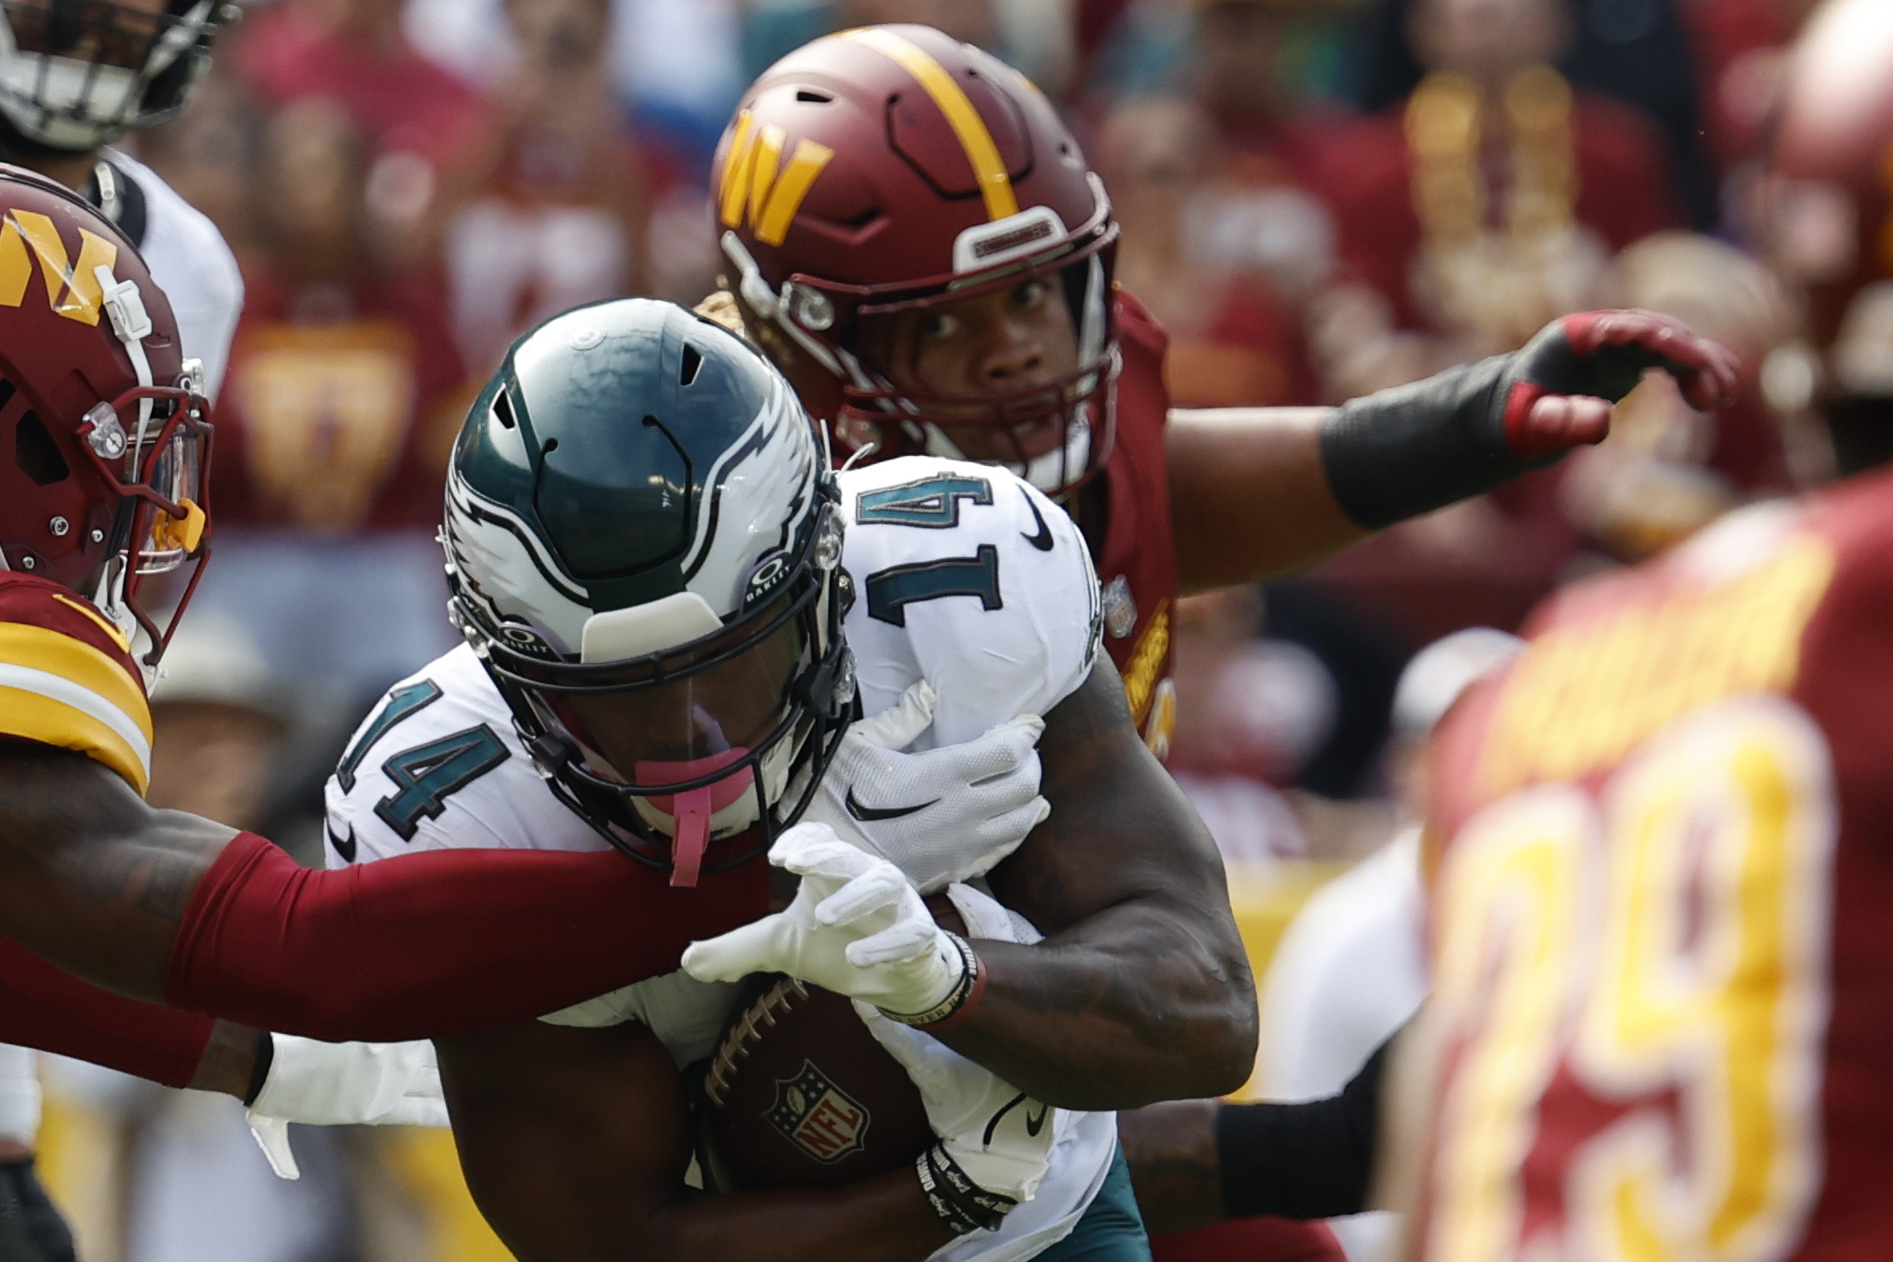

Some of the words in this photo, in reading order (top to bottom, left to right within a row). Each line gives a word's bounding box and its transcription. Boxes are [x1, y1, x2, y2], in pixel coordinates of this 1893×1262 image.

[745, 563, 791, 602] OAKLEY
[854, 472, 1002, 626] 14
[337, 678, 511, 842] 14
[795, 1097, 862, 1158] NFL
